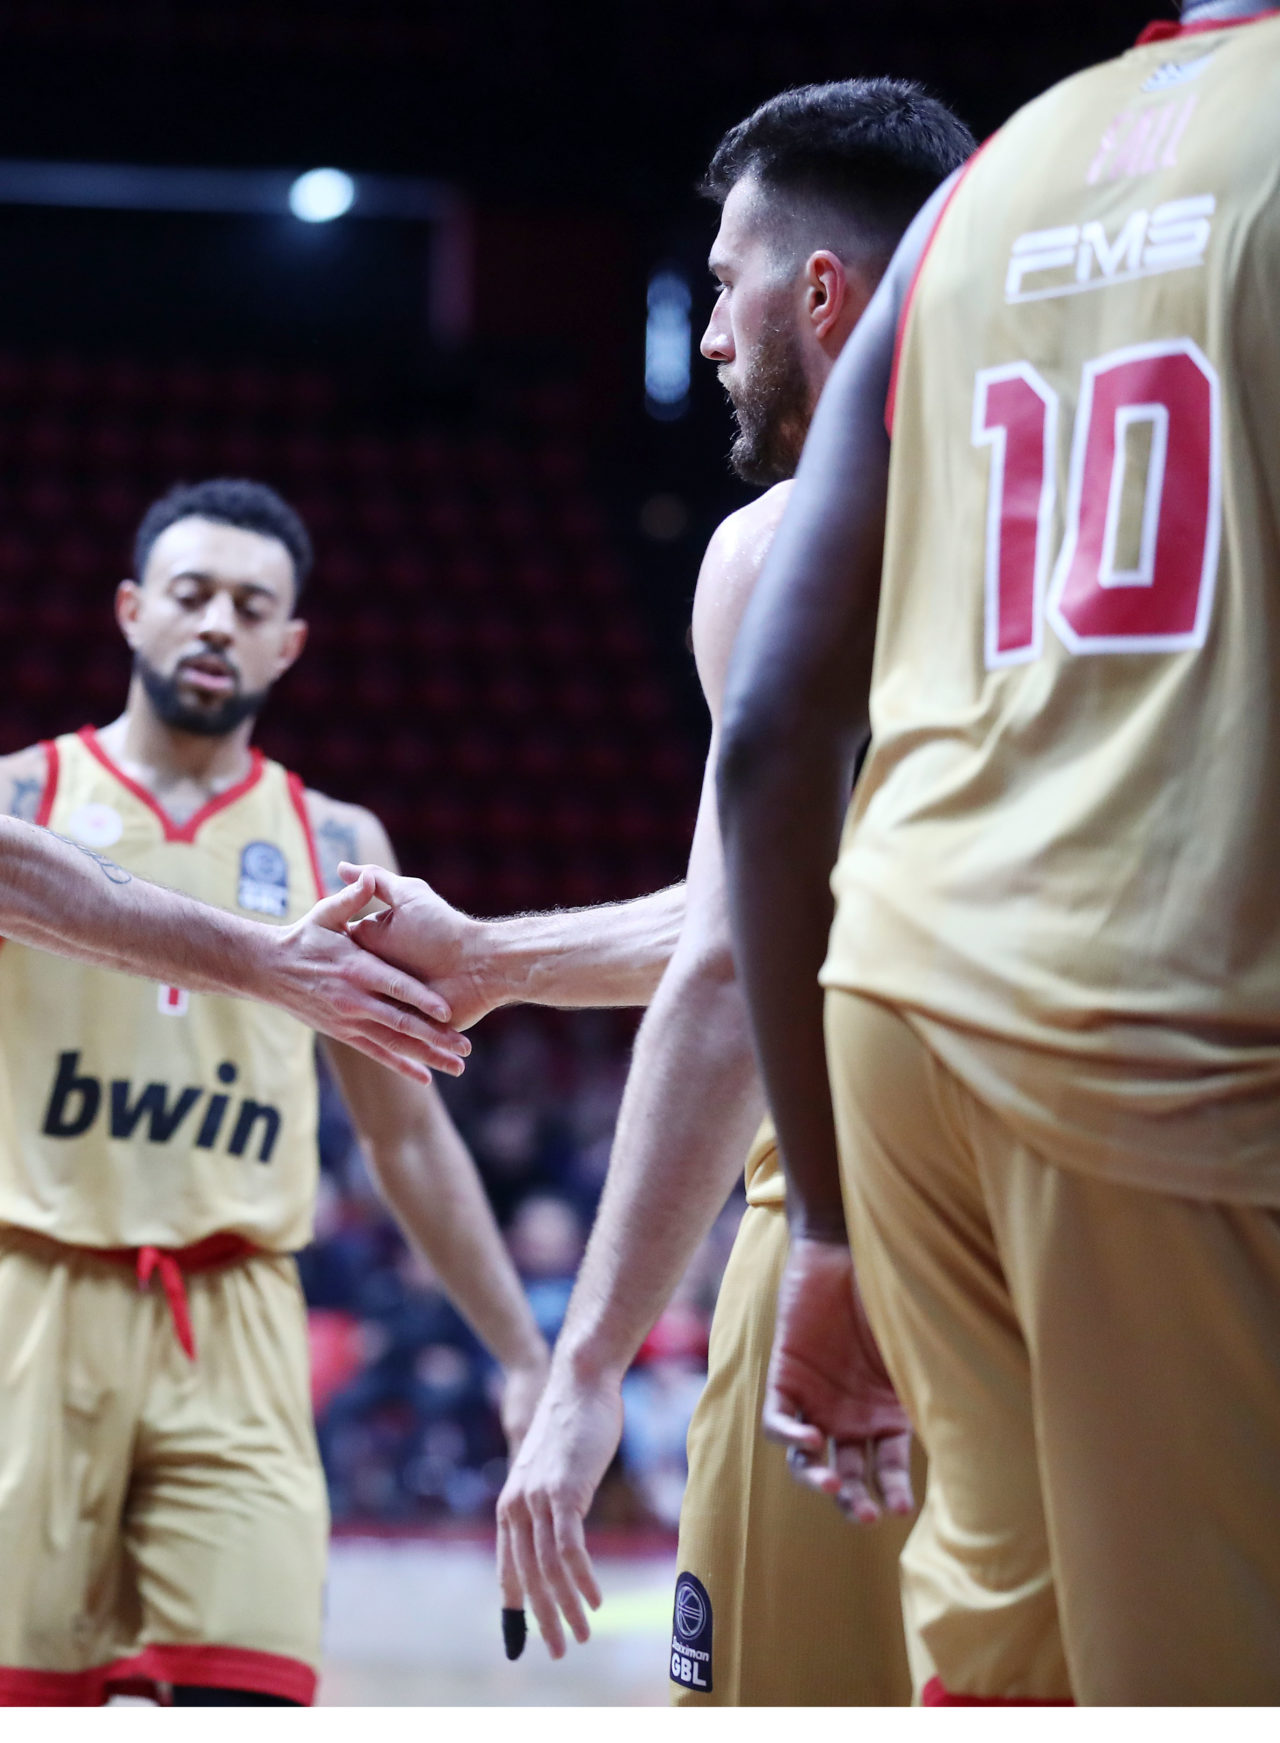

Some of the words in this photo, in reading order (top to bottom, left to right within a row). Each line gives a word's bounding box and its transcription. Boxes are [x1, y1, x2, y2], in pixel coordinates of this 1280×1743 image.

[1005, 193, 1216, 297] FMS
[971, 337, 1221, 671] 10
[42, 1050, 283, 1164] bwin
[671, 1652, 707, 1687] GBL
